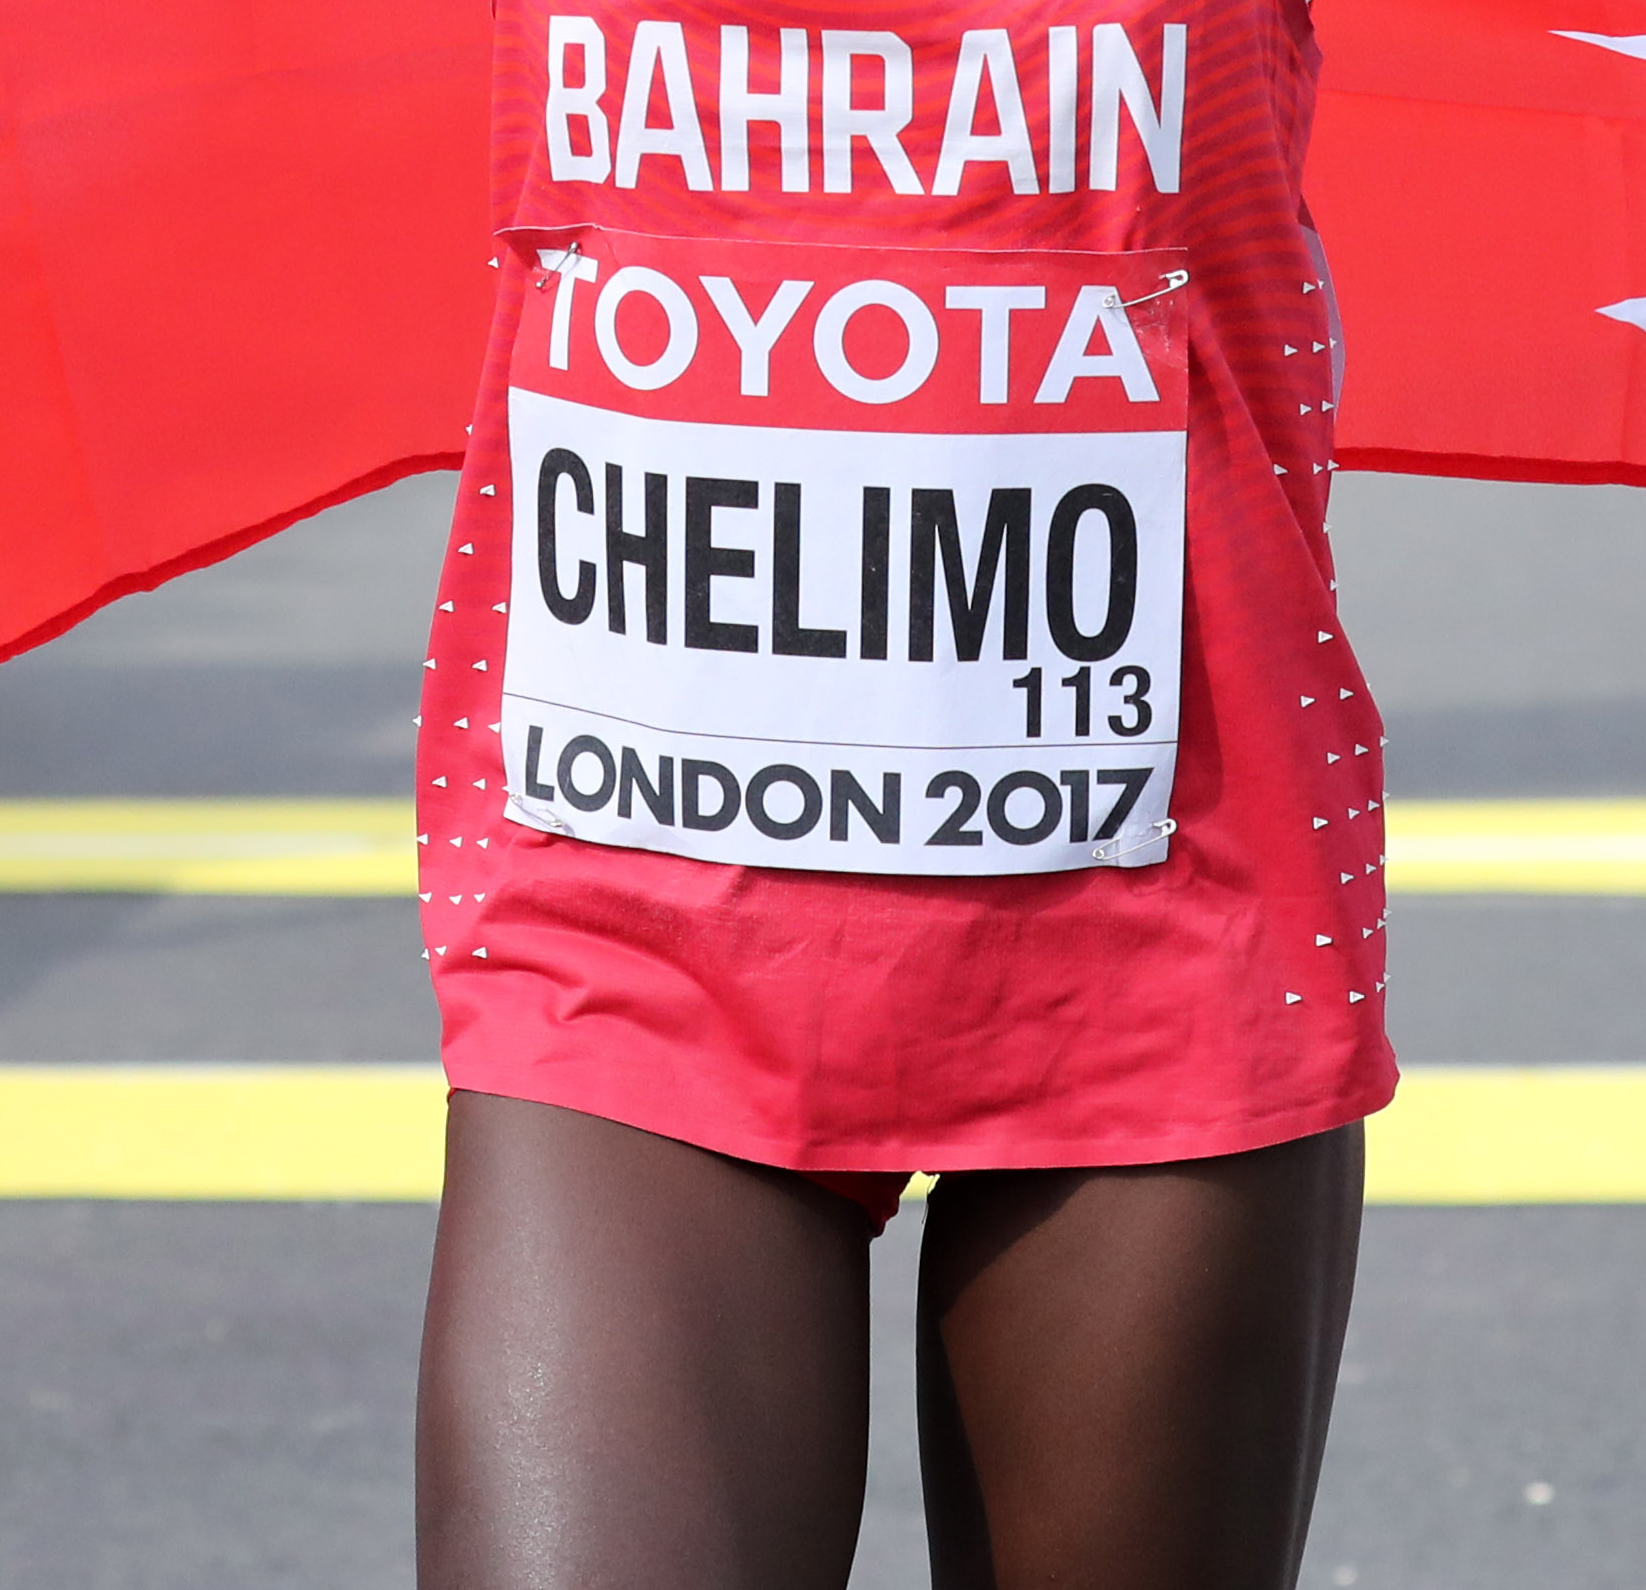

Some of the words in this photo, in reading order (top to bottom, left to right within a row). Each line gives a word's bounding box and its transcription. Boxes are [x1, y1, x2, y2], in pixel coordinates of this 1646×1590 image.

[545, 15, 1188, 197] BAHRAIN
[536, 247, 1160, 405] TOYOTA
[537, 448, 1138, 662] CHELIMO
[1011, 664, 1153, 738] 113
[525, 725, 902, 843] LONDON
[924, 767, 1155, 847] 2017
